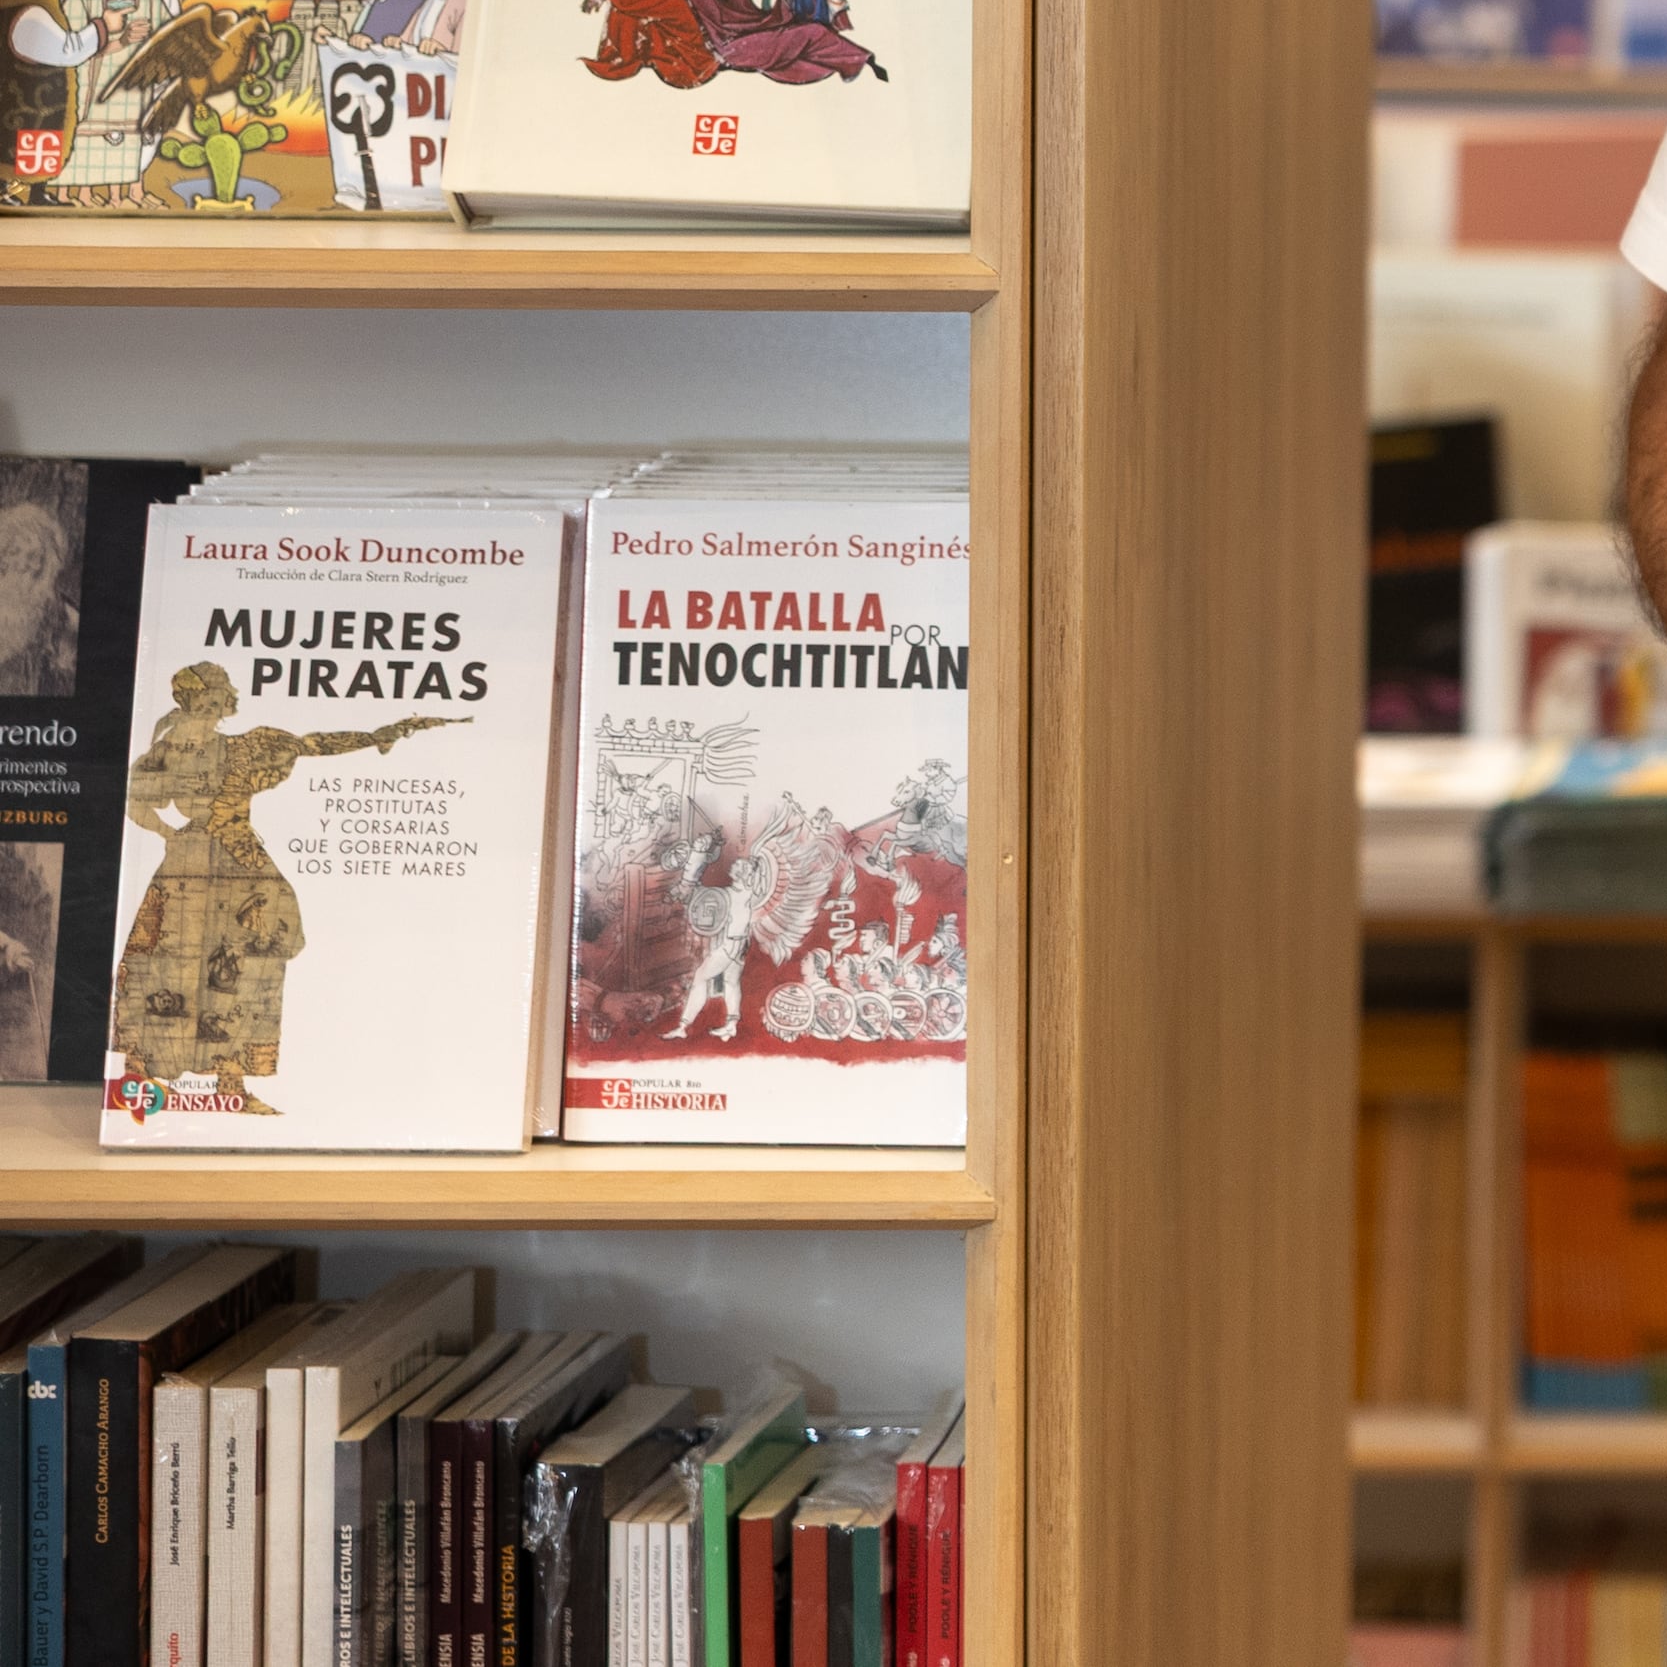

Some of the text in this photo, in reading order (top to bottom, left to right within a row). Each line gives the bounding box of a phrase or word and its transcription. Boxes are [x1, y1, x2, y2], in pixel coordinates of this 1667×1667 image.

[184, 535, 524, 566] Laura Sook Duncombe
[611, 532, 693, 556] Pedro
[702, 533, 839, 558] Salmerón
[236, 568, 306, 582] Traducción
[309, 569, 325, 582] de
[329, 570, 362, 582] Clara
[366, 571, 400, 583] Stern
[618, 590, 885, 632] LA BATALLA
[204, 608, 461, 652] MUJERES
[891, 625, 941, 646] POR
[251, 658, 488, 701] PIRATAS
[309, 778, 465, 798] LAS PRINCESAS,
[325, 798, 448, 815] PROSTITUTAS
[320, 819, 450, 835] Y CORSARIAS
[288, 838, 478, 856] QUE GOBERNARON
[297, 859, 466, 876] LOS SIETE MARES
[167, 1094, 244, 1111] ENSAYO
[632, 1094, 724, 1110] HISTORIA
[96, 1435, 109, 1493] CAMACHO
[34, 1444, 49, 1520] Dearborn
[96, 1496, 109, 1544] CARLOS
[404, 1499, 416, 1601] INTELECTUALES
[33, 1557, 49, 1602] David
[340, 1525, 352, 1628] INTELECTUALES
[501, 1545, 515, 1620] HISTORIA
